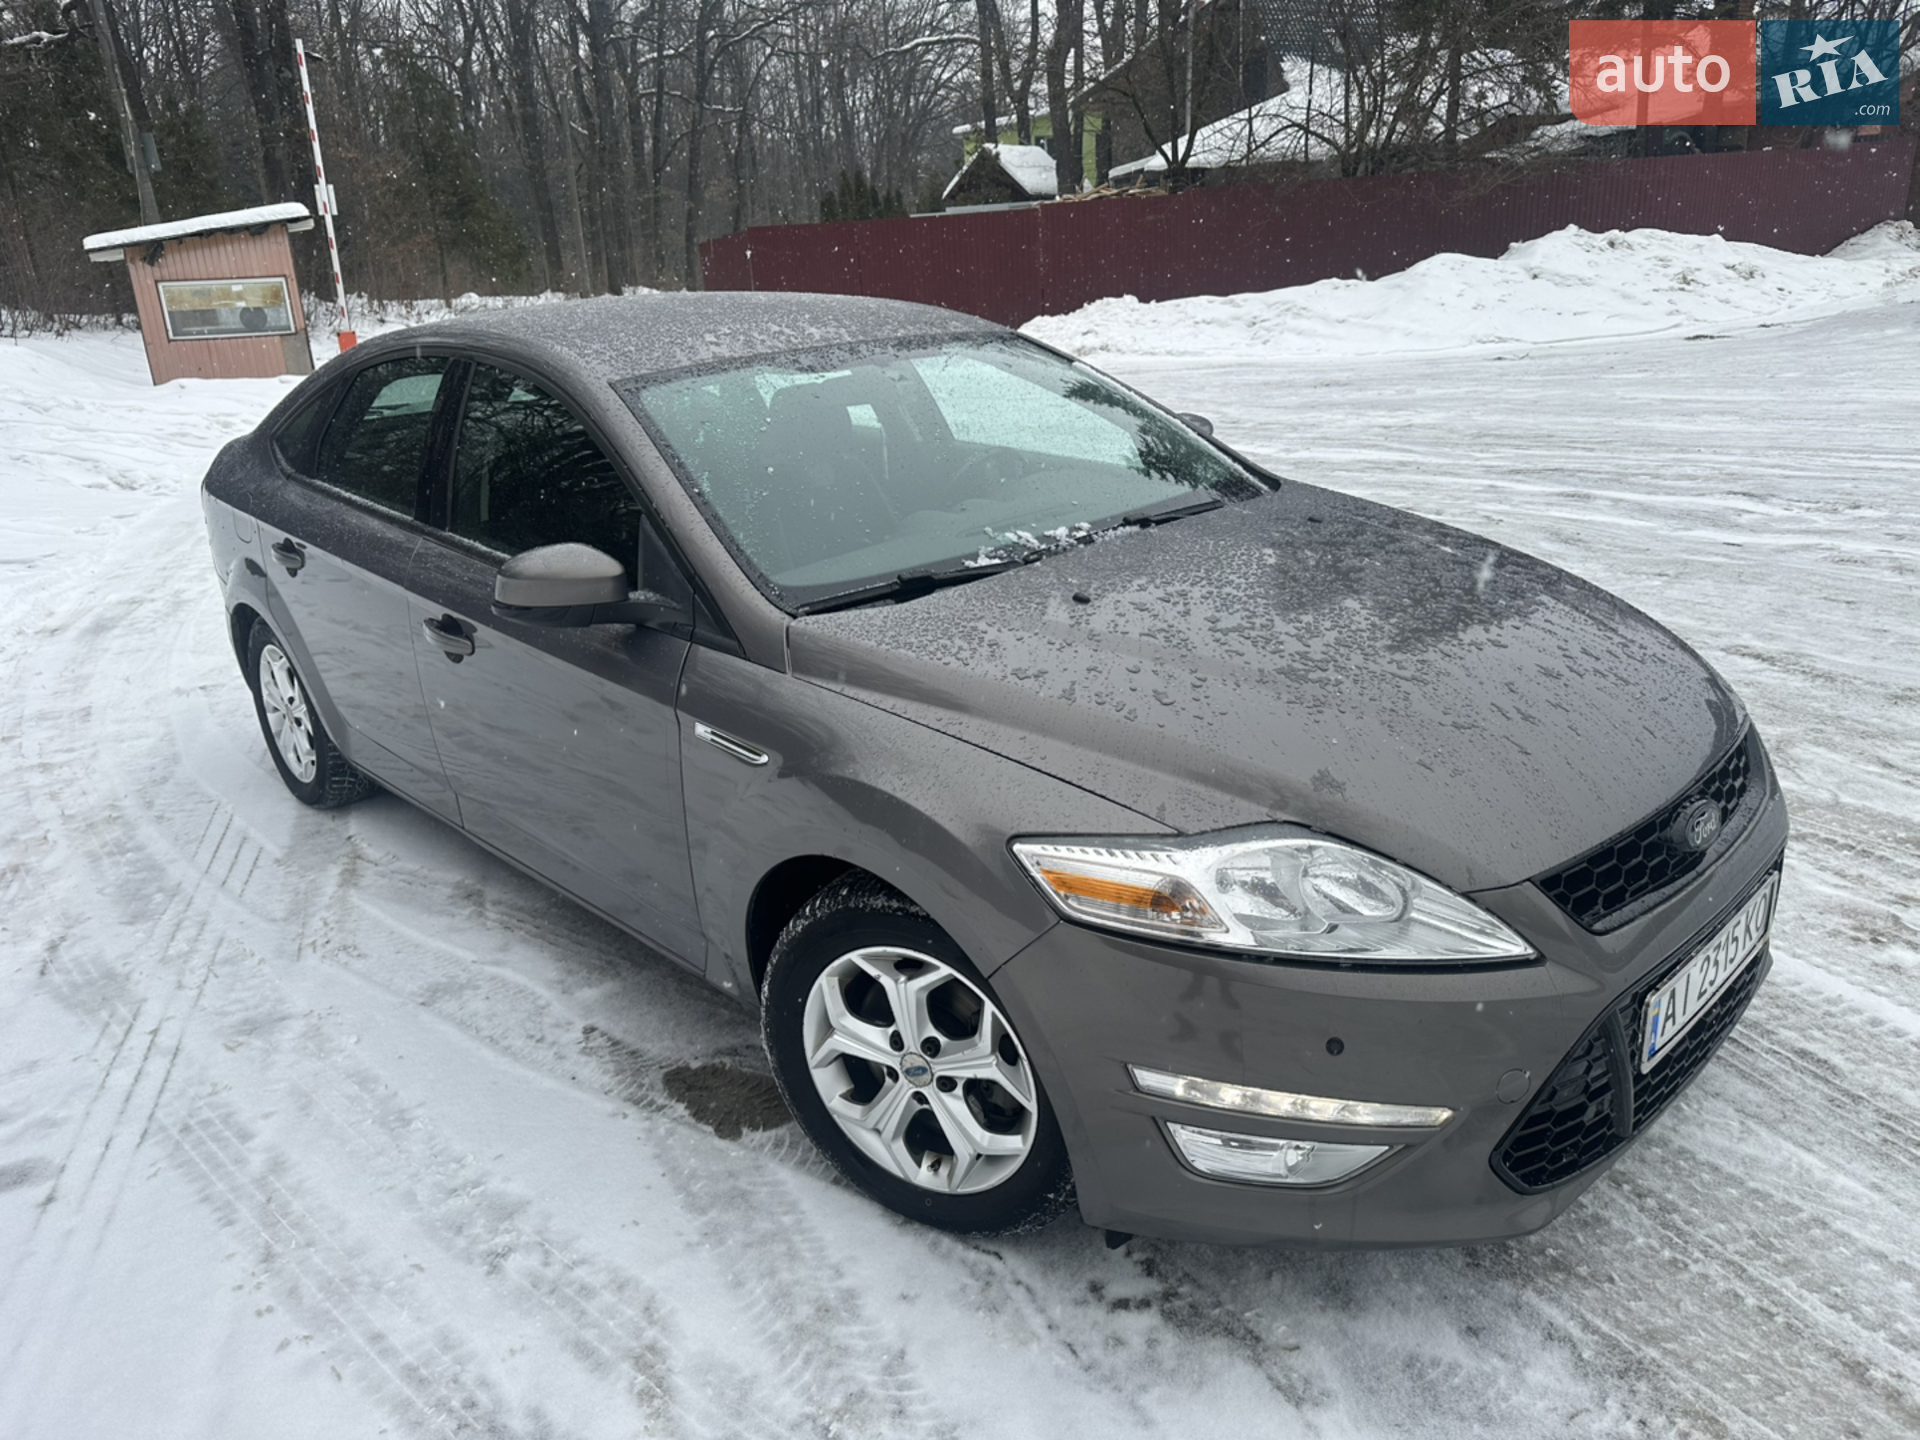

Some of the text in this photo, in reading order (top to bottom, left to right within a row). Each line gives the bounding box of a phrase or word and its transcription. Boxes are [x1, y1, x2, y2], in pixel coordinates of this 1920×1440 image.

[1694, 811, 1716, 844] Ford
[1661, 893, 1767, 1037] AI 2315 KO
